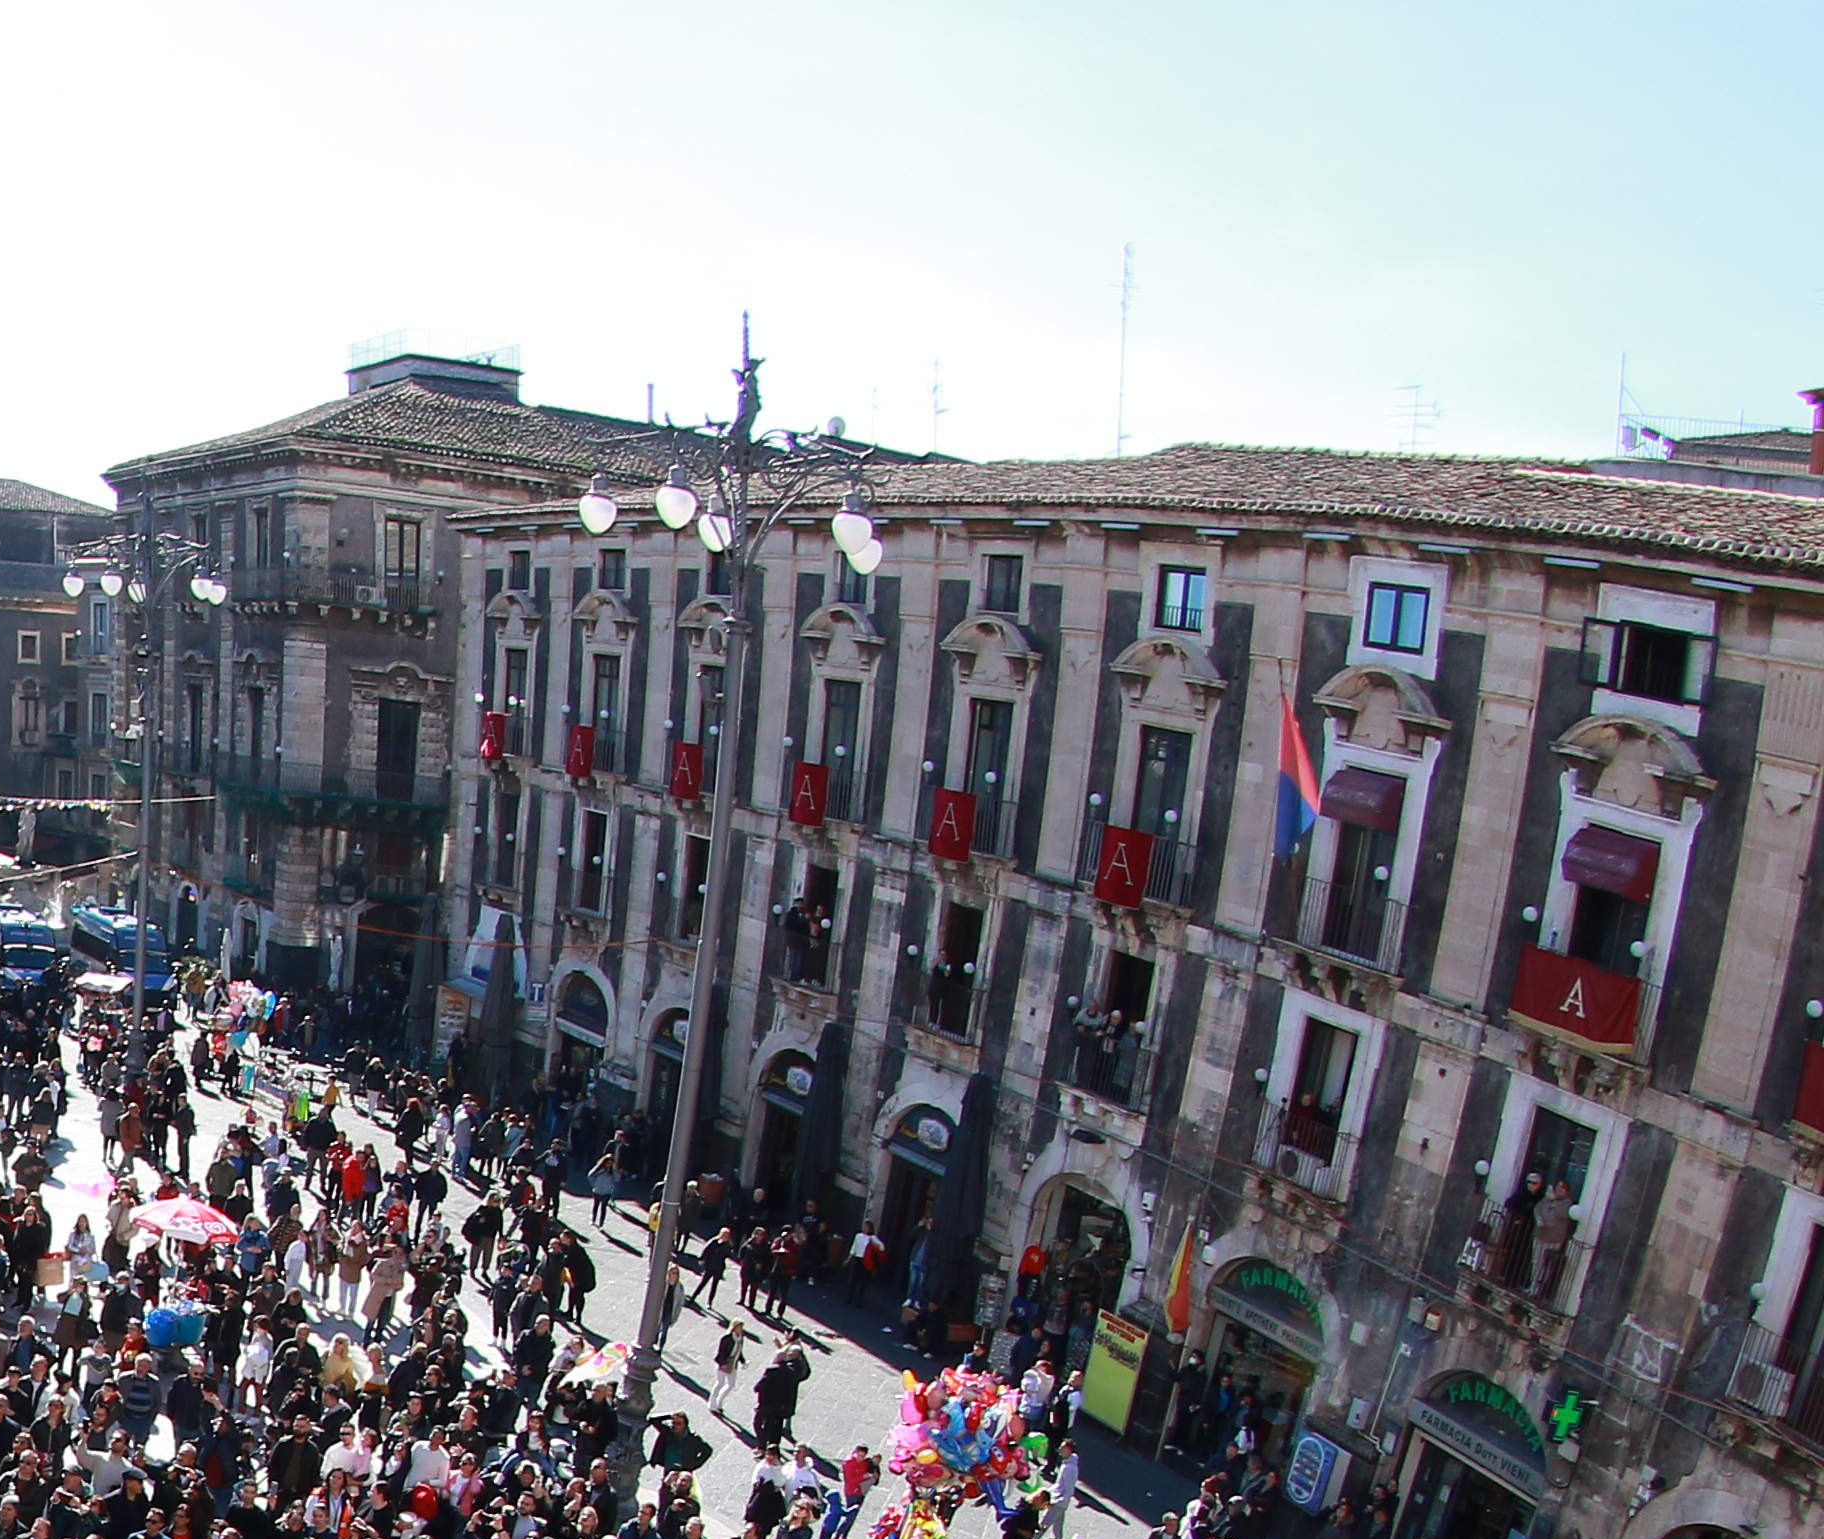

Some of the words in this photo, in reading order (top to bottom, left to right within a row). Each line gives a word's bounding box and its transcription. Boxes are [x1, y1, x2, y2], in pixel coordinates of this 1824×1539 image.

[570, 735, 585, 766] A
[674, 752, 693, 785] A
[795, 775, 816, 810] A
[936, 803, 961, 841] A
[1104, 842, 1135, 887] A
[532, 983, 544, 1002] T
[1559, 976, 1586, 1019] A
[1448, 1381, 1543, 1452] FARMACIA
[1419, 1410, 1472, 1450] FARMACIA
[1501, 1457, 1531, 1485] VIENI
